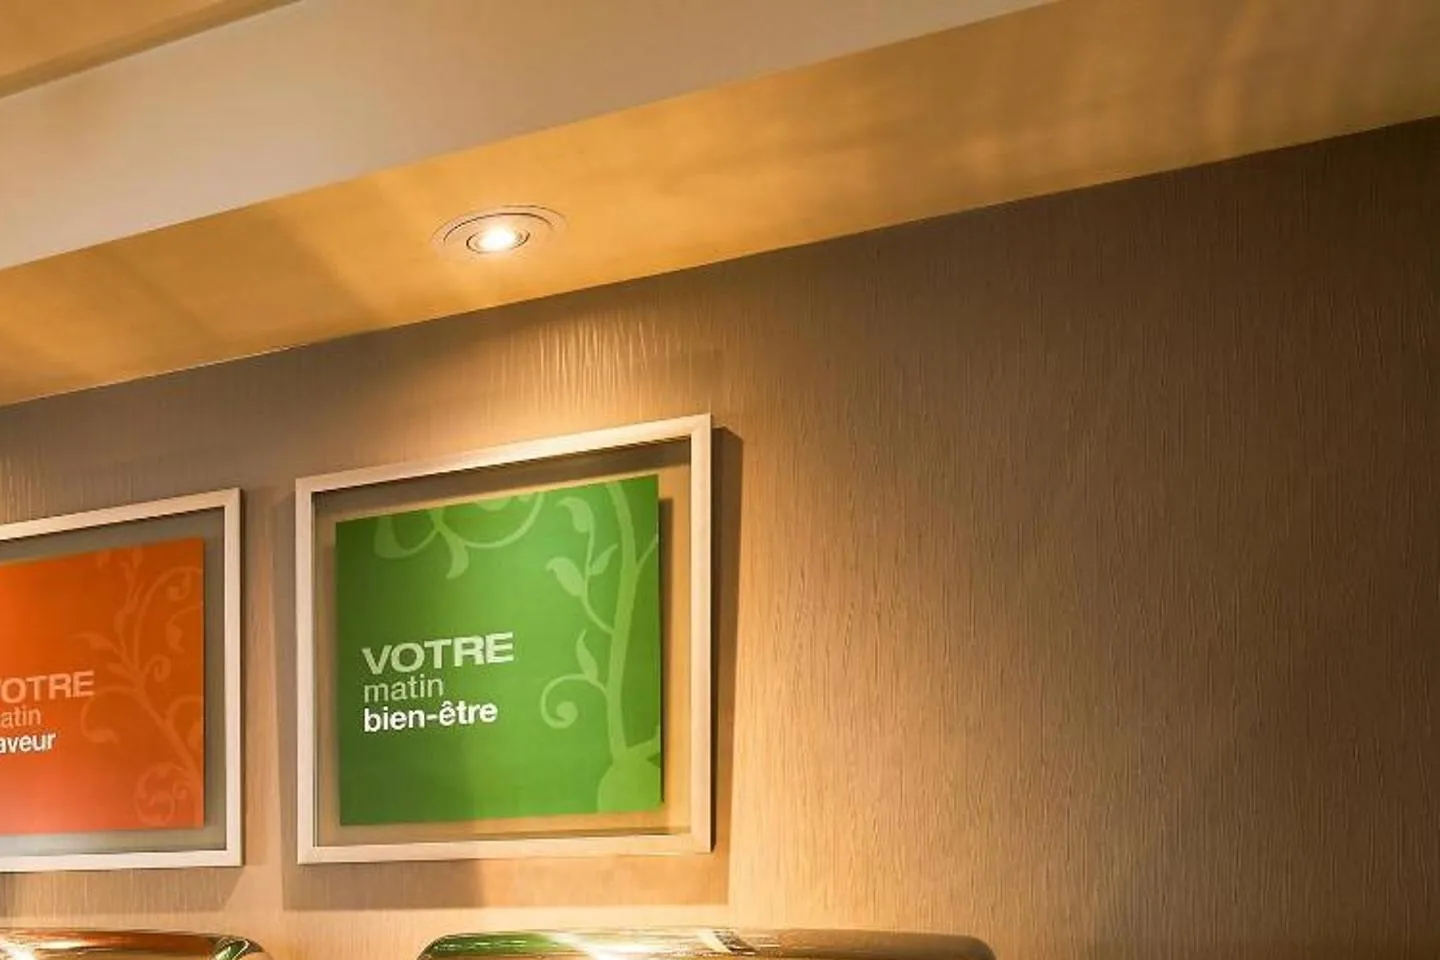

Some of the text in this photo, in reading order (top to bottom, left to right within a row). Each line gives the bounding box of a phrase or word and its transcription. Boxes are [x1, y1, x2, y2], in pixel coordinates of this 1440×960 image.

[361, 631, 515, 675] VOTRE
[363, 673, 445, 703] matin
[363, 700, 498, 733] bien-être
